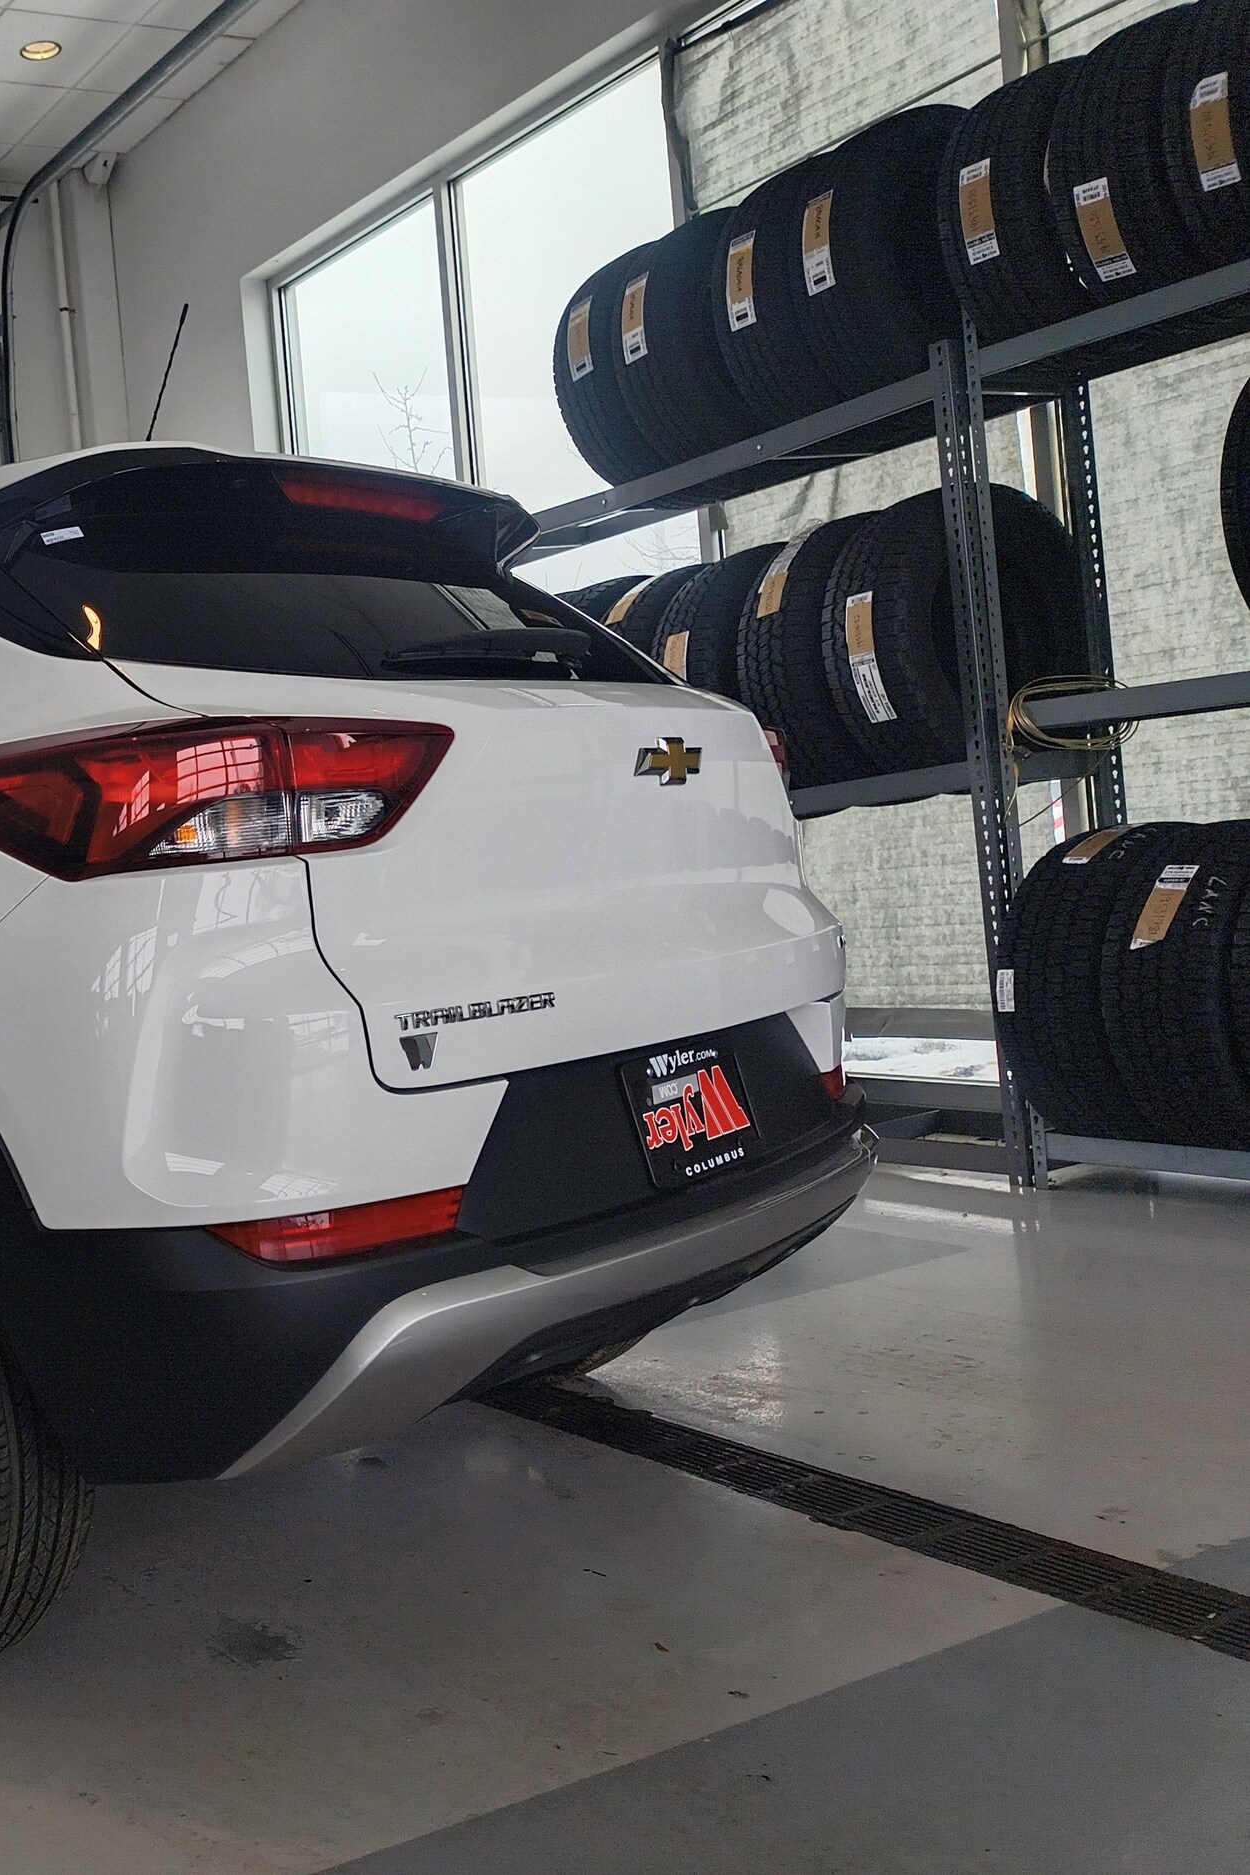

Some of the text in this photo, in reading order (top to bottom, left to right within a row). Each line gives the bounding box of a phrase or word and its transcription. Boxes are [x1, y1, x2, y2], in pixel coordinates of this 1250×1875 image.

[1192, 876, 1227, 928] LANC
[394, 992, 556, 1031] TRAILBLAZER
[642, 1065, 751, 1152] Wyler
[685, 1147, 745, 1177] COLUMBUS
